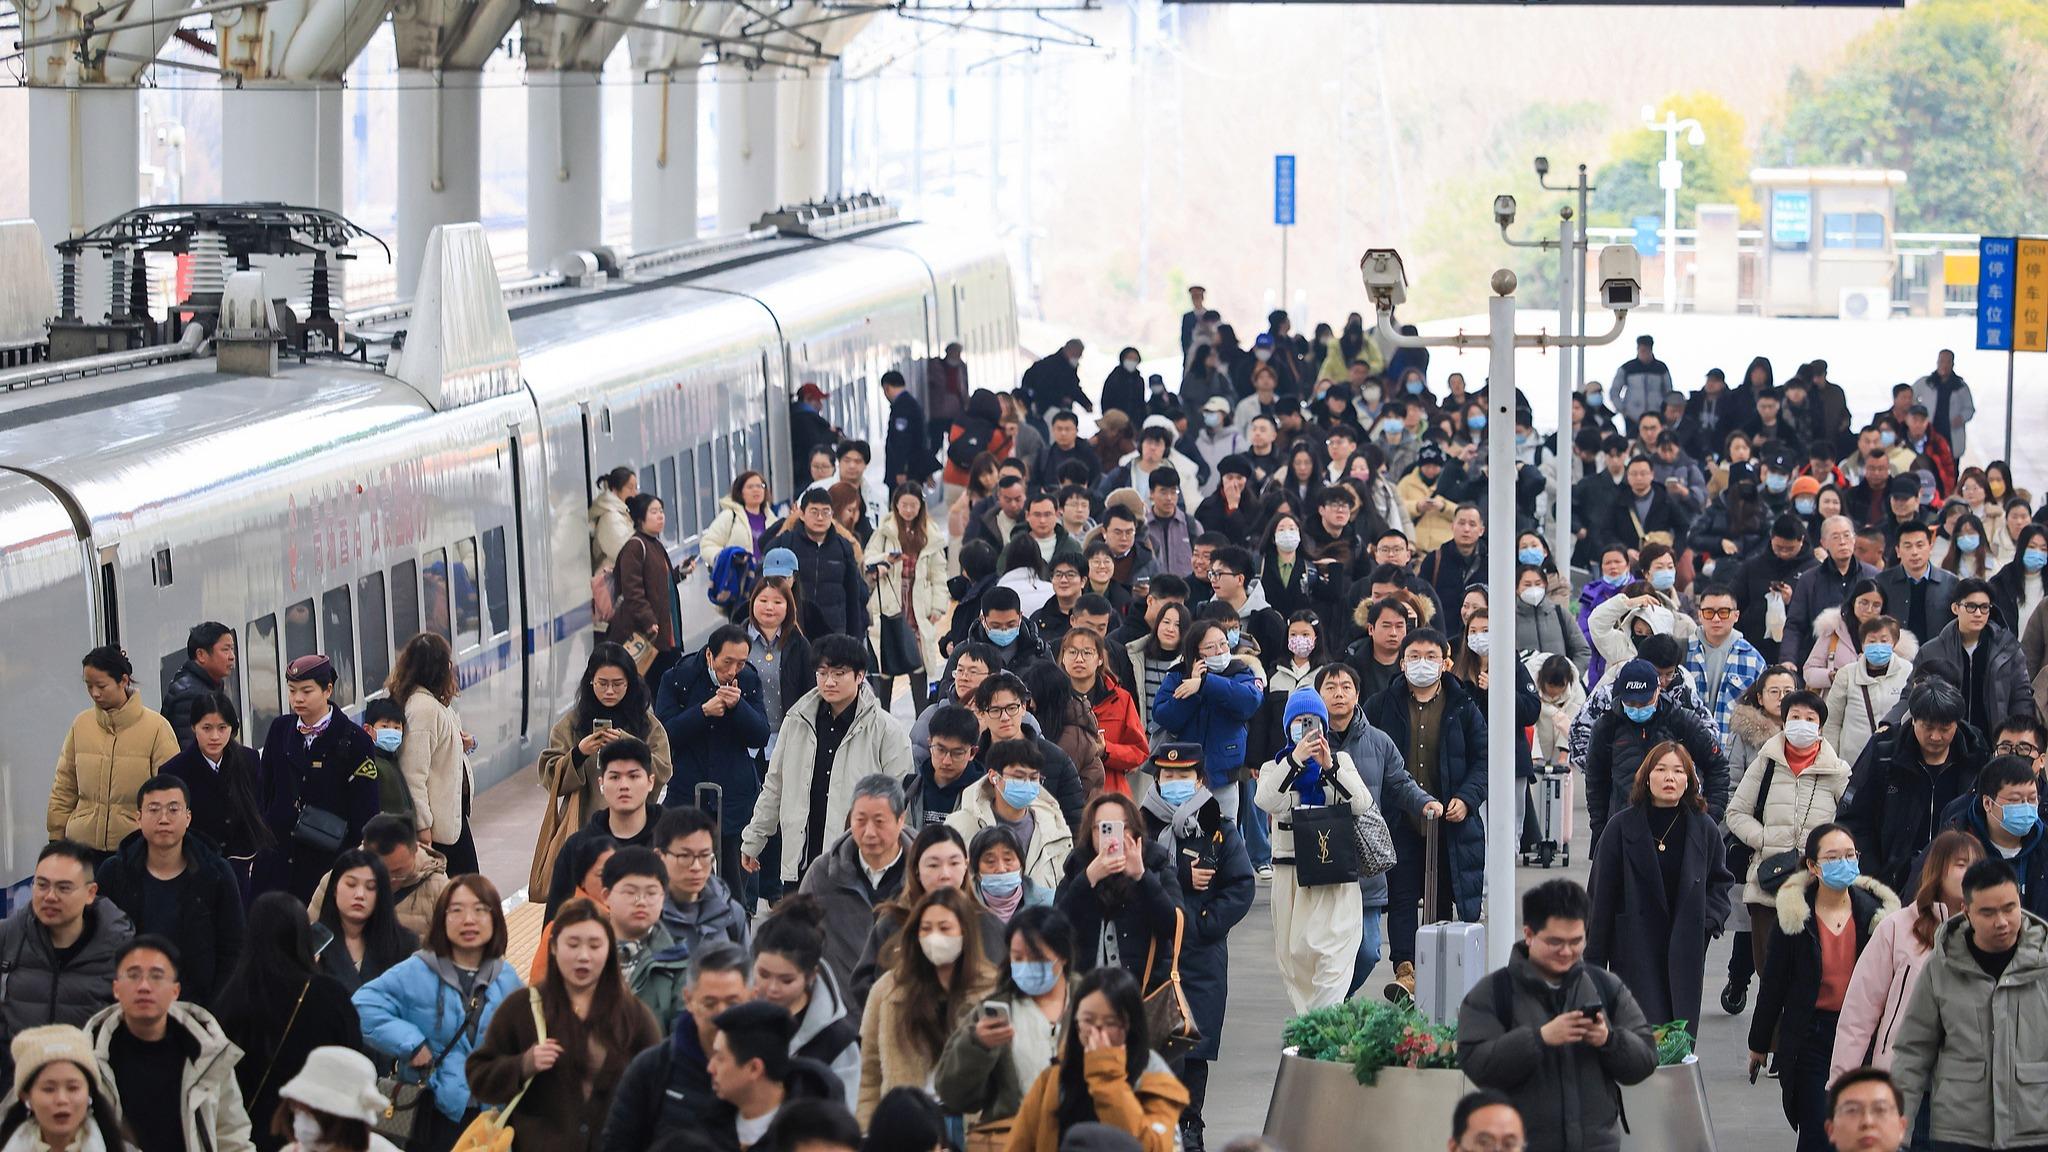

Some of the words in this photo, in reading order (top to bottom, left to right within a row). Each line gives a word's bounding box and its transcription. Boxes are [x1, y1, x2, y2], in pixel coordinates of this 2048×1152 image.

[1985, 243, 2009, 256] CRH
[2023, 245, 2046, 257] CRH
[1986, 261, 2005, 346] 停车位置
[2024, 263, 2041, 346] 停车位置
